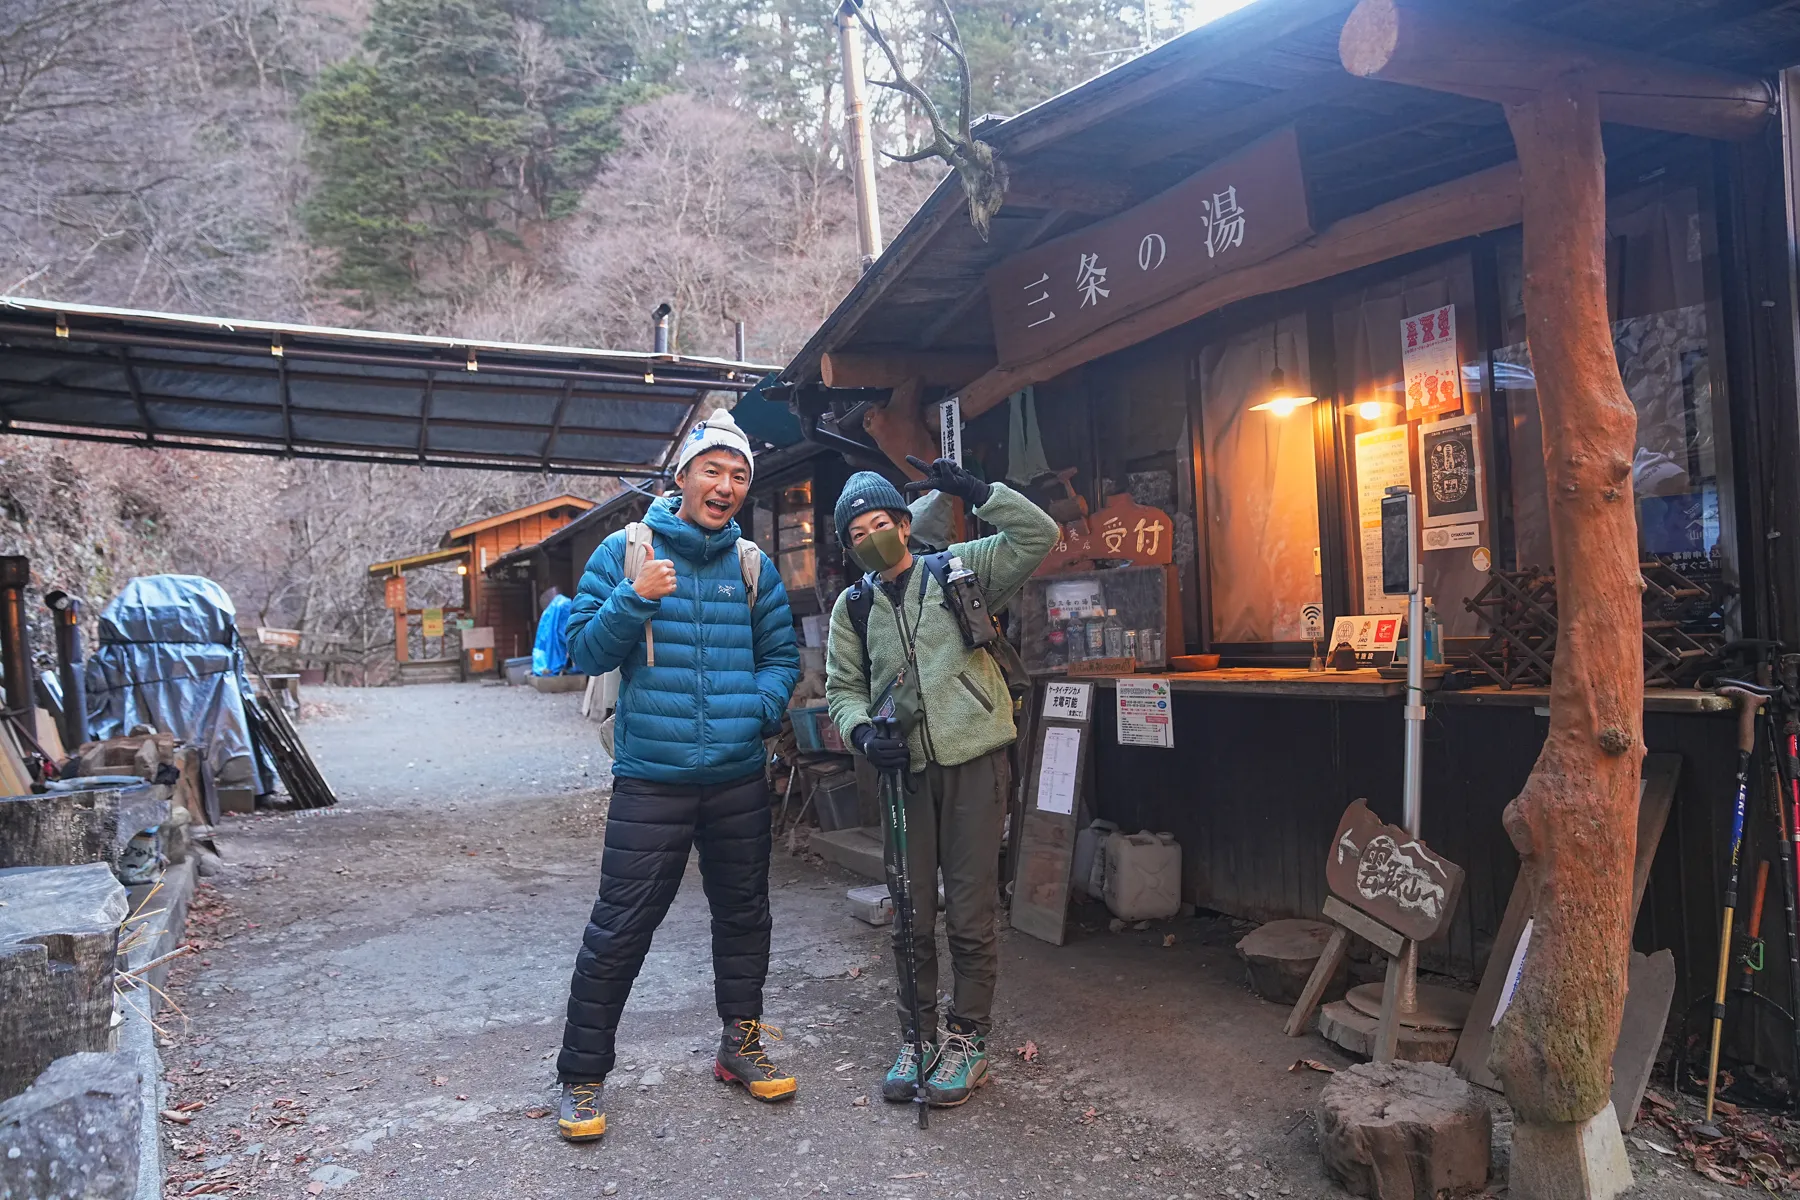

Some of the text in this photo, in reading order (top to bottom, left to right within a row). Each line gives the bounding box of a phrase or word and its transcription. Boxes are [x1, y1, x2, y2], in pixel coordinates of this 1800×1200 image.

[1022, 184, 1246, 329] 三条の湯
[1102, 516, 1165, 556] 受付
[1048, 685, 1081, 695] ケータイ・デジカメ
[1052, 696, 1078, 708] 充電可能
[1737, 783, 1747, 816] LEKI
